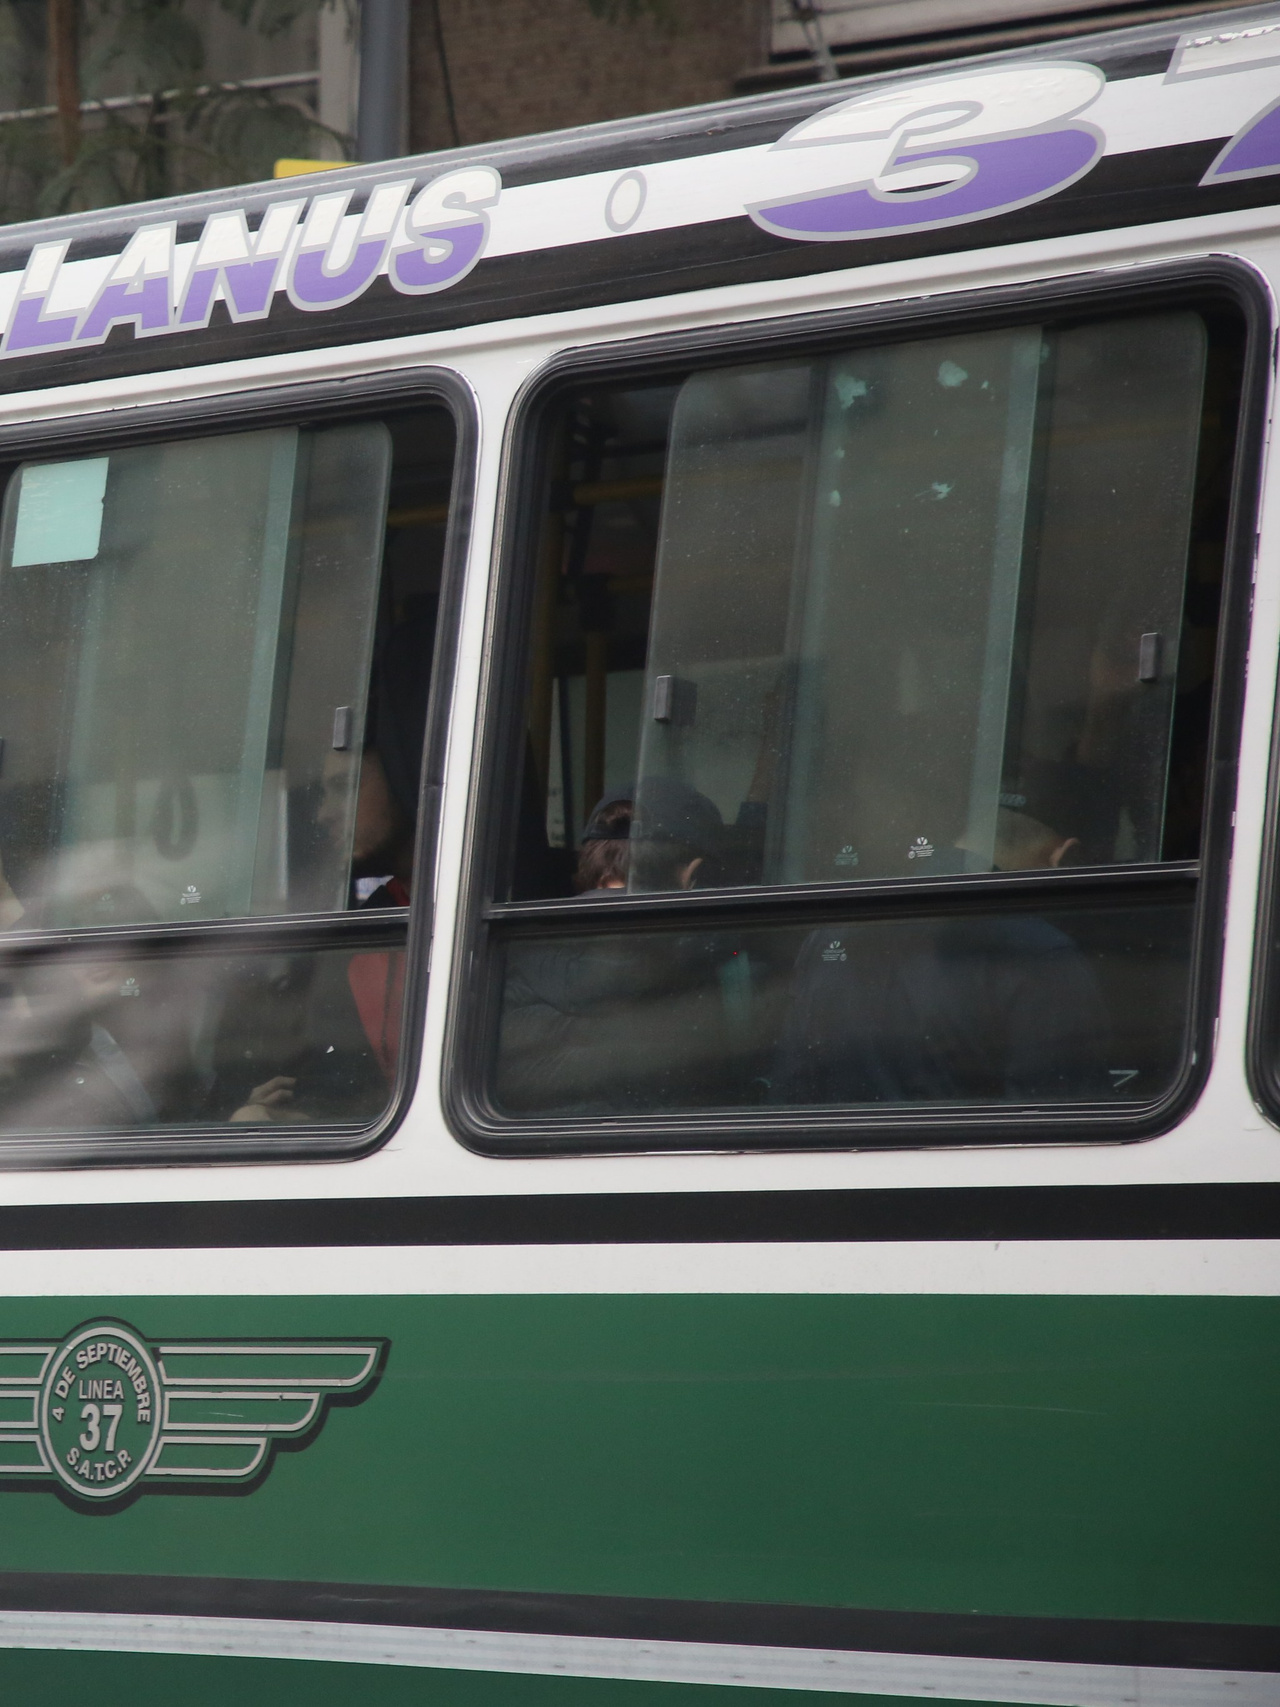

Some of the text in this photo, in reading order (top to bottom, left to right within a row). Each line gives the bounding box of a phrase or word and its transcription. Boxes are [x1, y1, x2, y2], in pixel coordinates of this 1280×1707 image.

[52, 1342, 152, 1423] 4 DE SEPTIEMBRE
[78, 1379, 125, 1400] LINEA
[79, 1403, 123, 1452] 37
